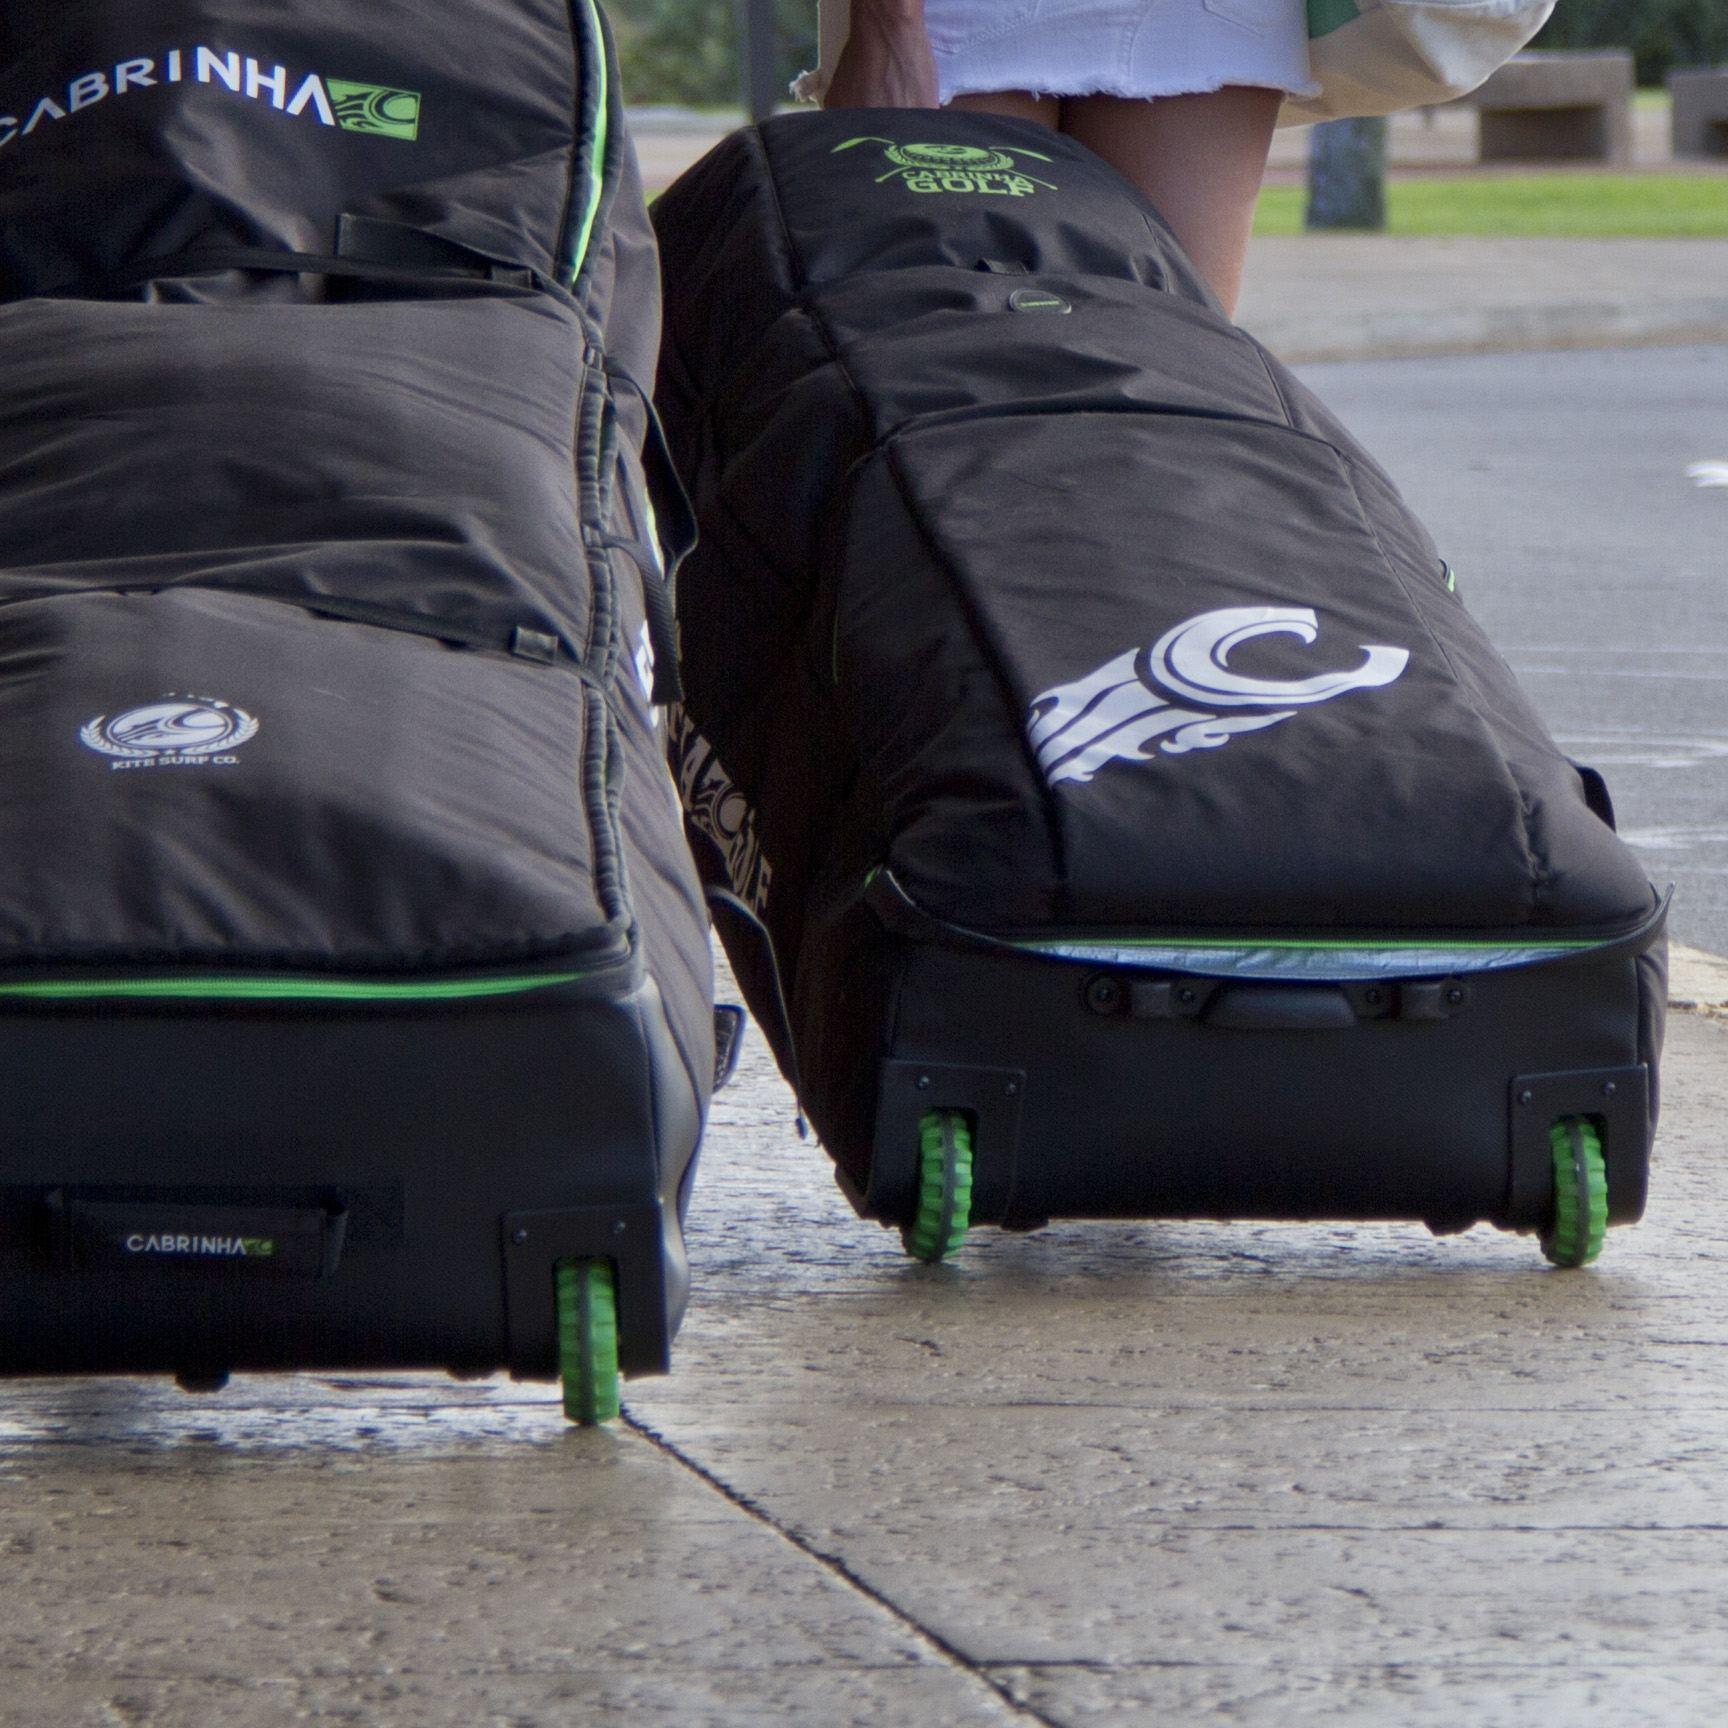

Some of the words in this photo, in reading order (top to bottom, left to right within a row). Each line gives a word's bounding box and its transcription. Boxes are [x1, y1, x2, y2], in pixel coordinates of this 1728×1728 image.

[901, 169, 1035, 188] CABRINHA
[905, 177, 1036, 198] GOLF
[111, 757, 155, 770] KITE
[158, 756, 210, 767] SURF
[126, 1234, 248, 1256] CABRINHA
